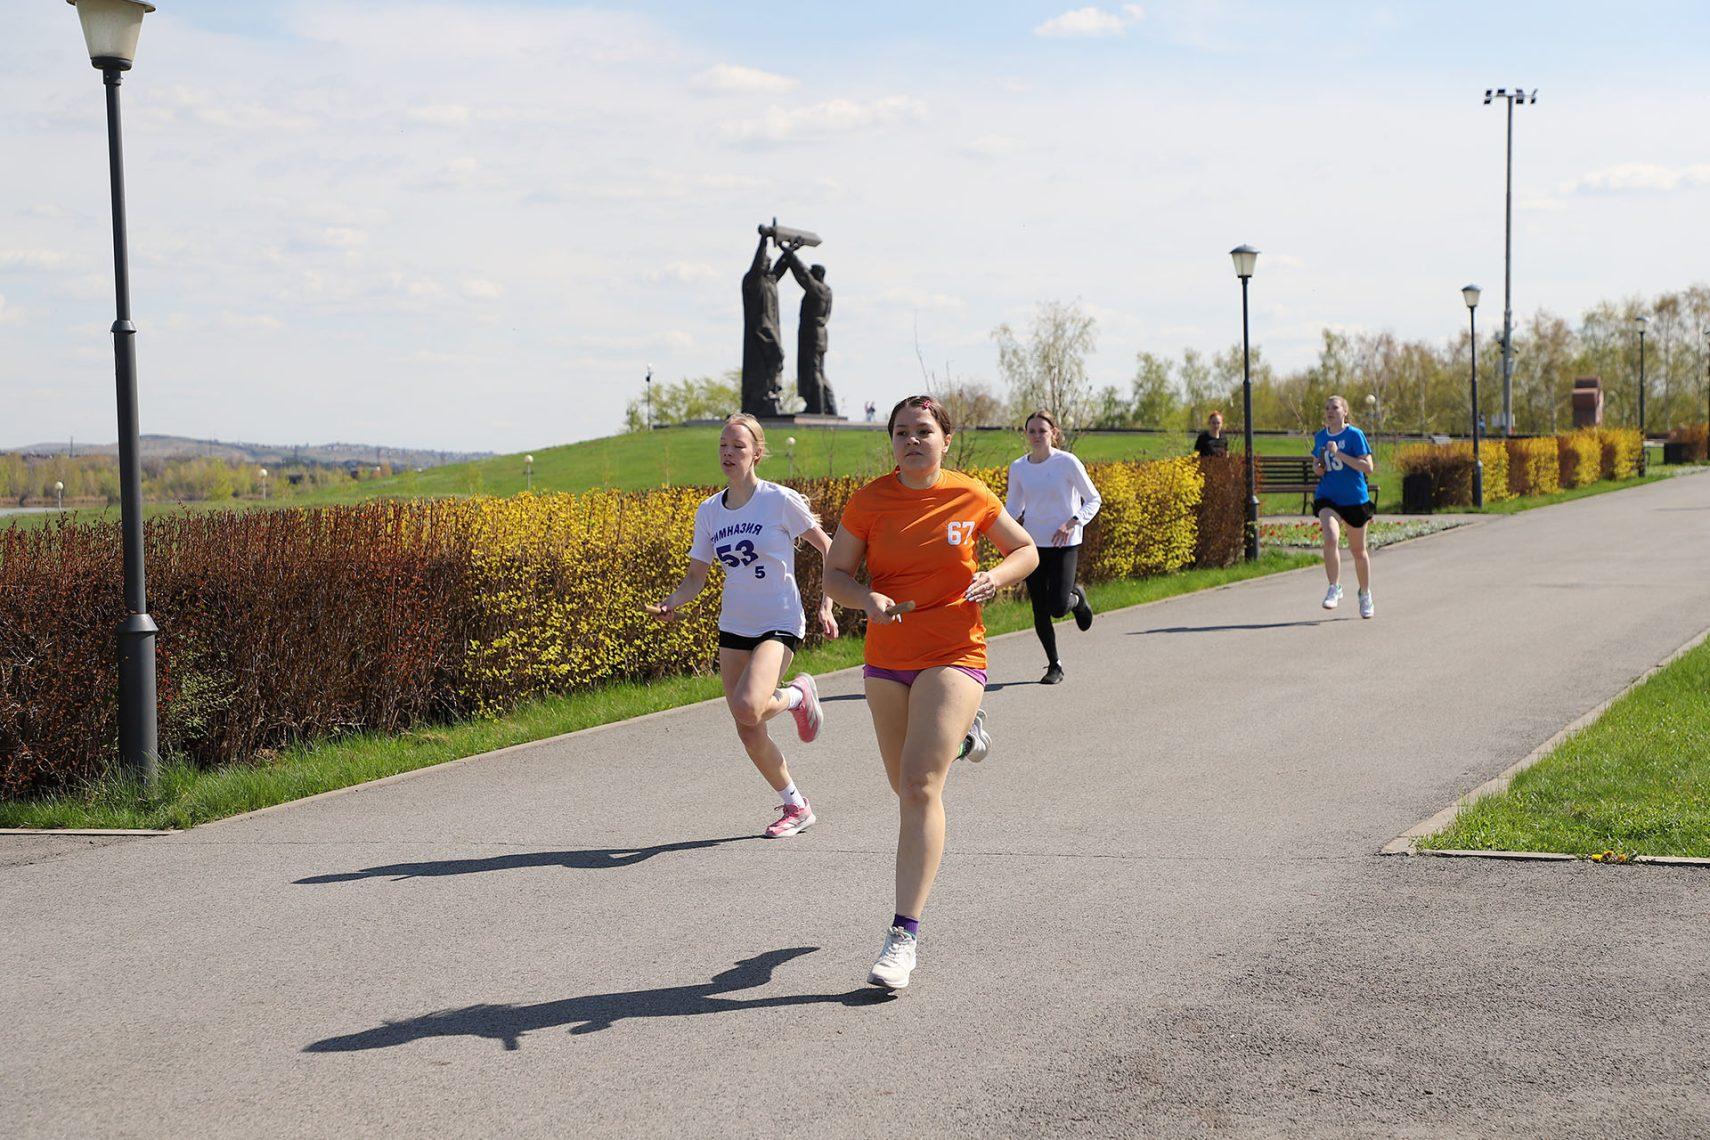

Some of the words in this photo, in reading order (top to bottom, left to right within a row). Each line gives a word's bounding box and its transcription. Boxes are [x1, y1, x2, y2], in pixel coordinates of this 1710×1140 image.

[947, 521, 975, 545] 67
[716, 540, 759, 567] 53
[755, 566, 766, 579] 5
